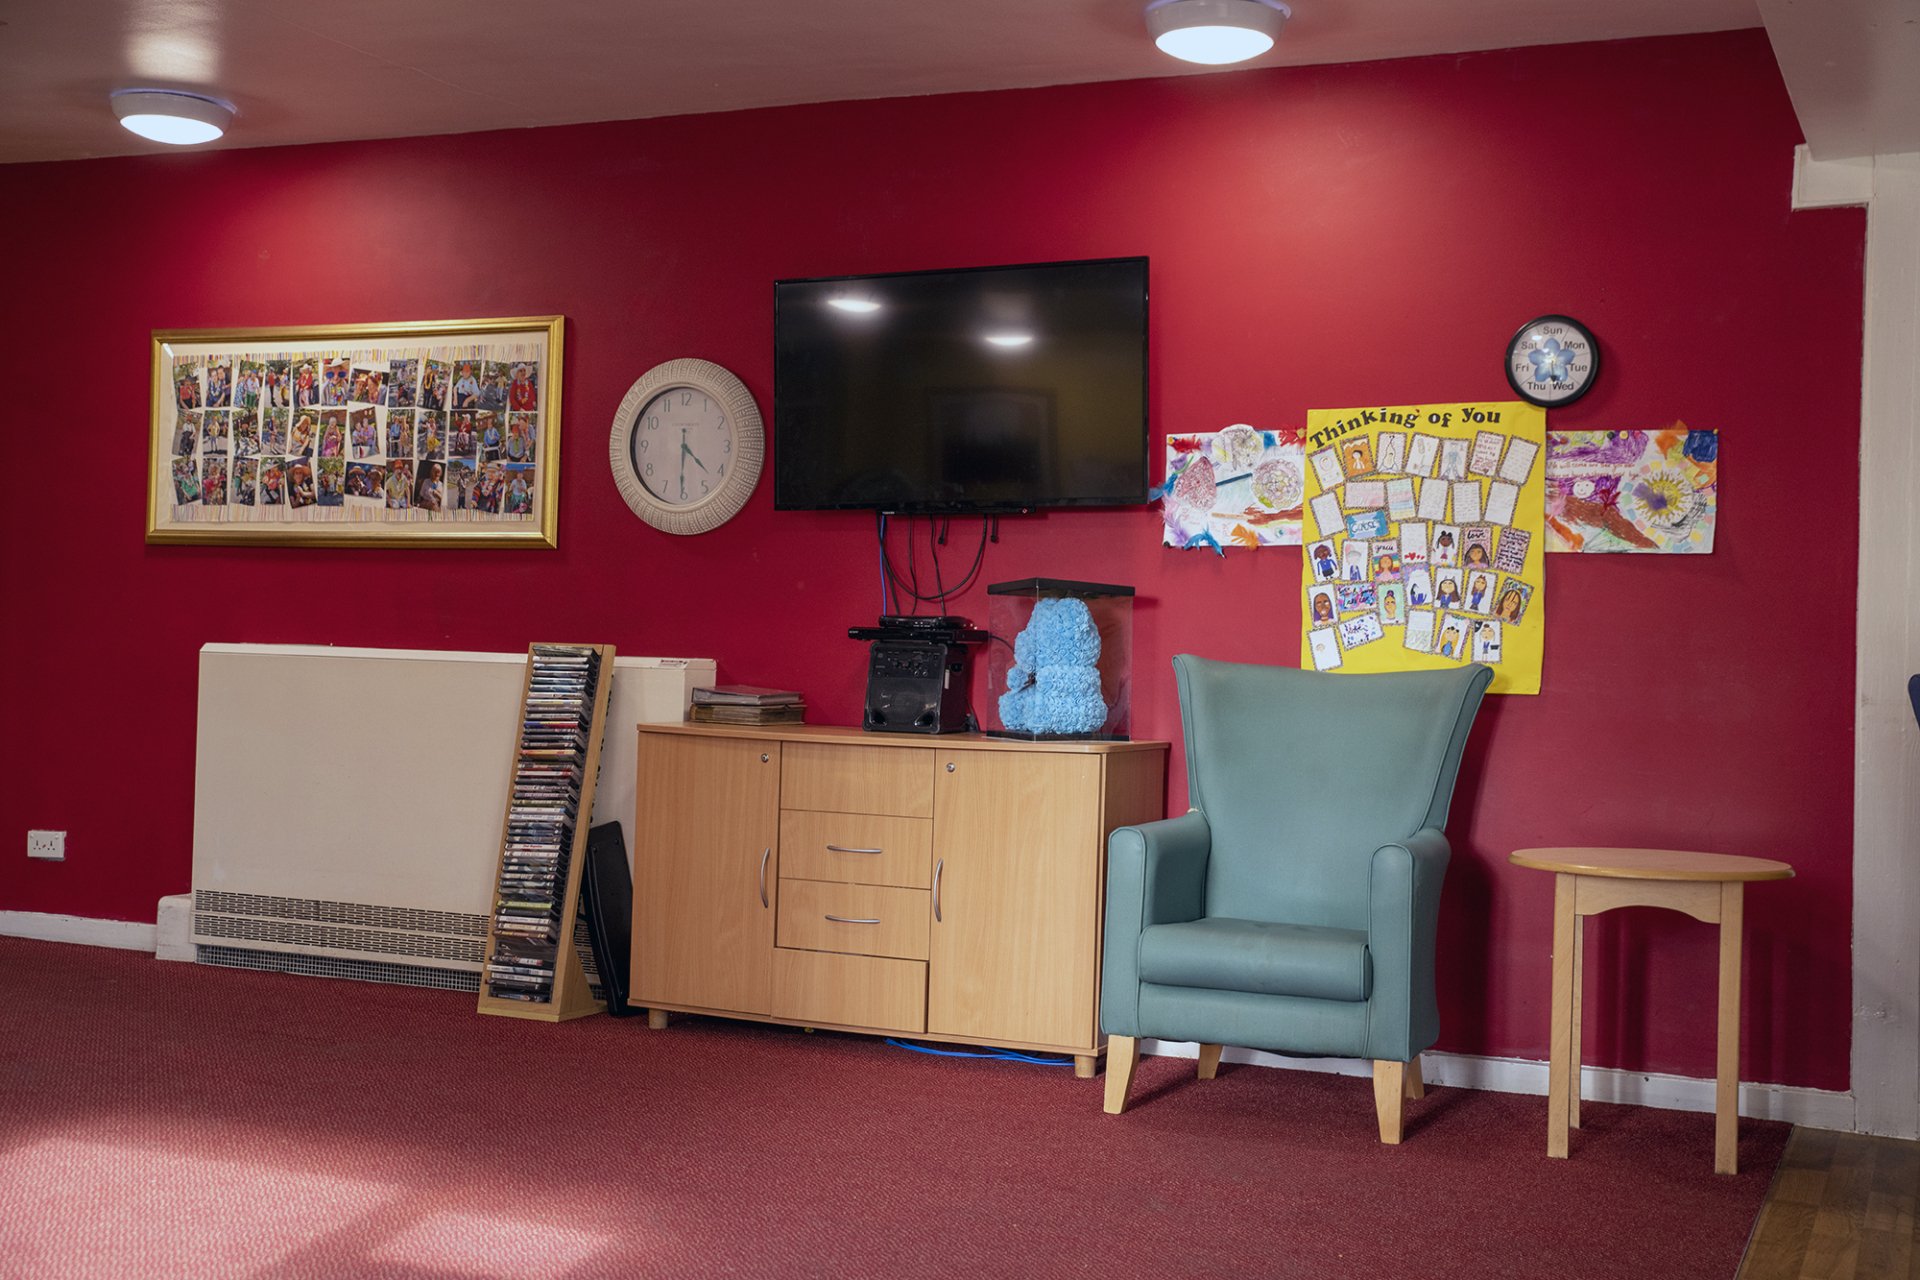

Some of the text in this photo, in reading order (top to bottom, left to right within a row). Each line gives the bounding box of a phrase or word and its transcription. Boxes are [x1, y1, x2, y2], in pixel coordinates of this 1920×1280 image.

[1543, 326, 1562, 335] Sun
[1521, 341, 1538, 350] Sat
[1564, 341, 1585, 349] Mon
[1515, 363, 1530, 372] Fri
[1570, 363, 1588, 372] Tue
[1528, 382, 1546, 391] Thu
[1552, 382, 1574, 391] Wed
[663, 399, 671, 413] 11
[681, 392, 692, 407] 12
[703, 399, 708, 413] 1
[647, 416, 659, 430] 10
[717, 416, 725, 430] 2
[1309, 408, 1419, 449] Thinking
[1428, 412, 1452, 427] of
[640, 440, 649, 454] 9
[723, 440, 731, 454] 3
[645, 463, 654, 477] 8
[717, 464, 725, 477] 4
[662, 480, 668, 494] 7
[680, 487, 688, 501] 6
[701, 480, 709, 494] 5
